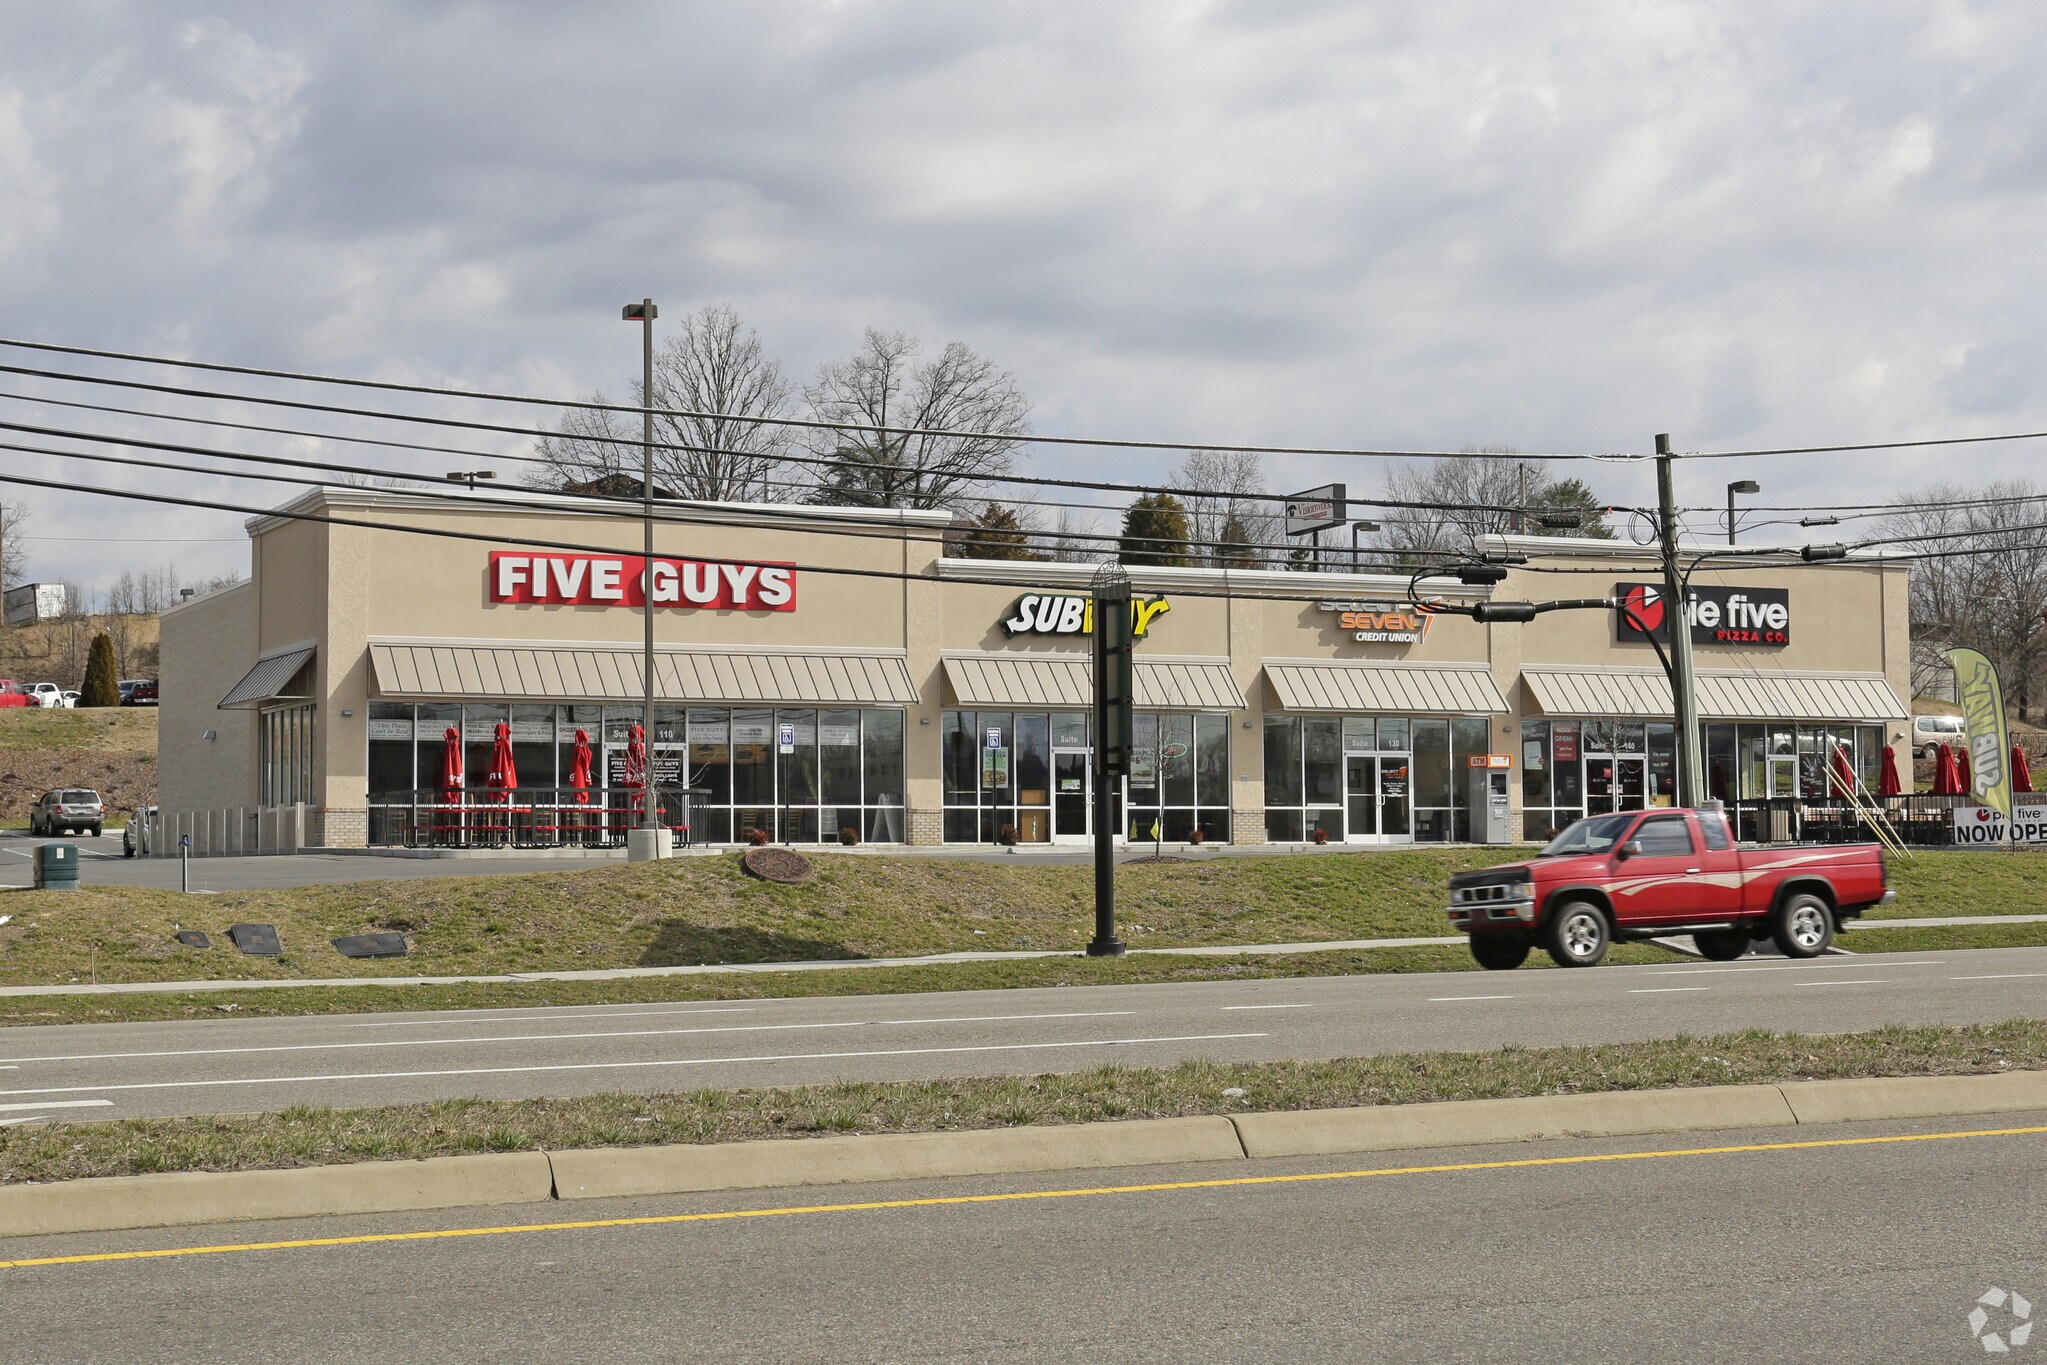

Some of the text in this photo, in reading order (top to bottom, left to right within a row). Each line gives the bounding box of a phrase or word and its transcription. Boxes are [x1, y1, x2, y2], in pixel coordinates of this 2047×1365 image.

[499, 557, 792, 605] FIVE GUYS
[1007, 595, 1171, 635] SUBY
[1687, 593, 1788, 630] ie five
[1341, 612, 1415, 630] SEVEN
[1355, 631, 1418, 643] CREDIT UNION
[1716, 630, 1788, 643] PIZZA CO.
[613, 730, 673, 739] Suit 110
[1060, 735, 1078, 744] Suite
[1352, 739, 1400, 748] Suite 130
[1472, 756, 1487, 766] ATM
[2018, 808, 2041, 819] five
[1957, 825, 2004, 843] NOW
